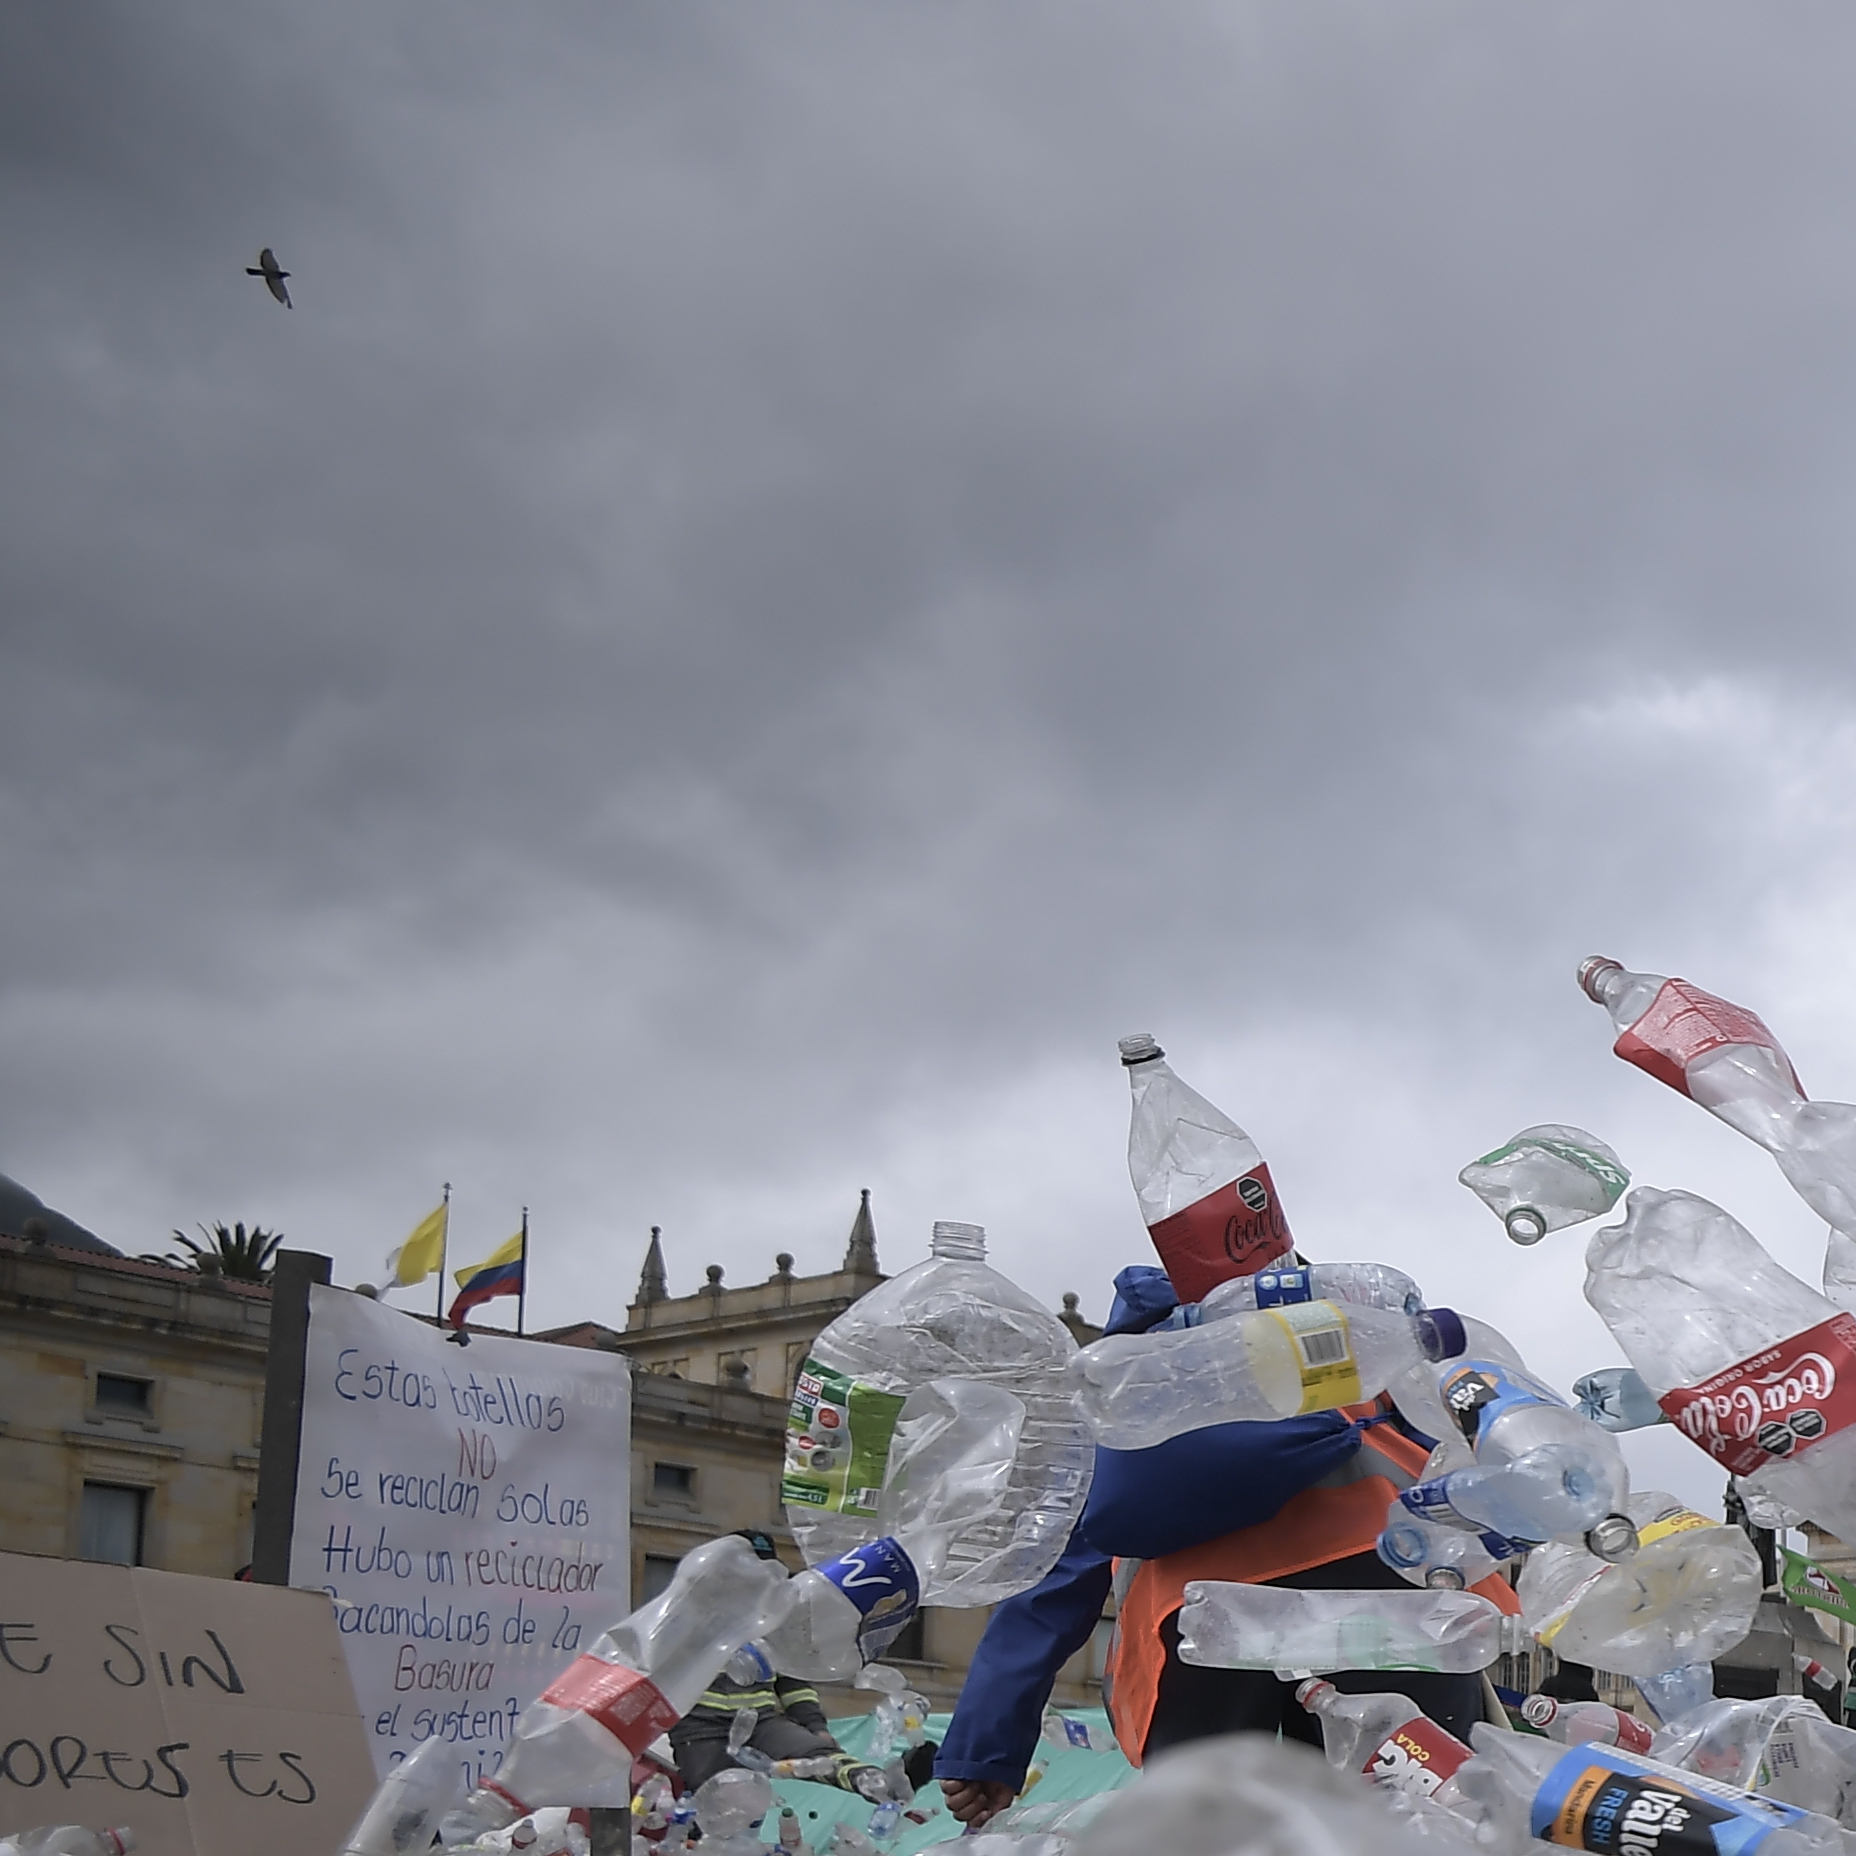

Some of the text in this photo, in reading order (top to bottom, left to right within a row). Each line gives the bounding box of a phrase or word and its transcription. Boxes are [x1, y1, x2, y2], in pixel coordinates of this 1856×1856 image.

[335, 1350, 565, 1432] Estas botellas
[1680, 1352, 1837, 1456] Coca-Cola
[458, 1427, 497, 1481] NO
[379, 1473, 480, 1518] reciclan
[322, 1525, 604, 1593] Hubo un reciclador
[503, 1598, 537, 1645] de
[104, 1624, 245, 1694] SIN
[395, 1644, 495, 1692] Basura
[375, 1703, 402, 1737] el
[0, 1735, 317, 1804] ORES ES
[1396, 1733, 1431, 1763] COLA
[1591, 1786, 1630, 1846] FRESH
[1661, 1804, 1692, 1833] del
